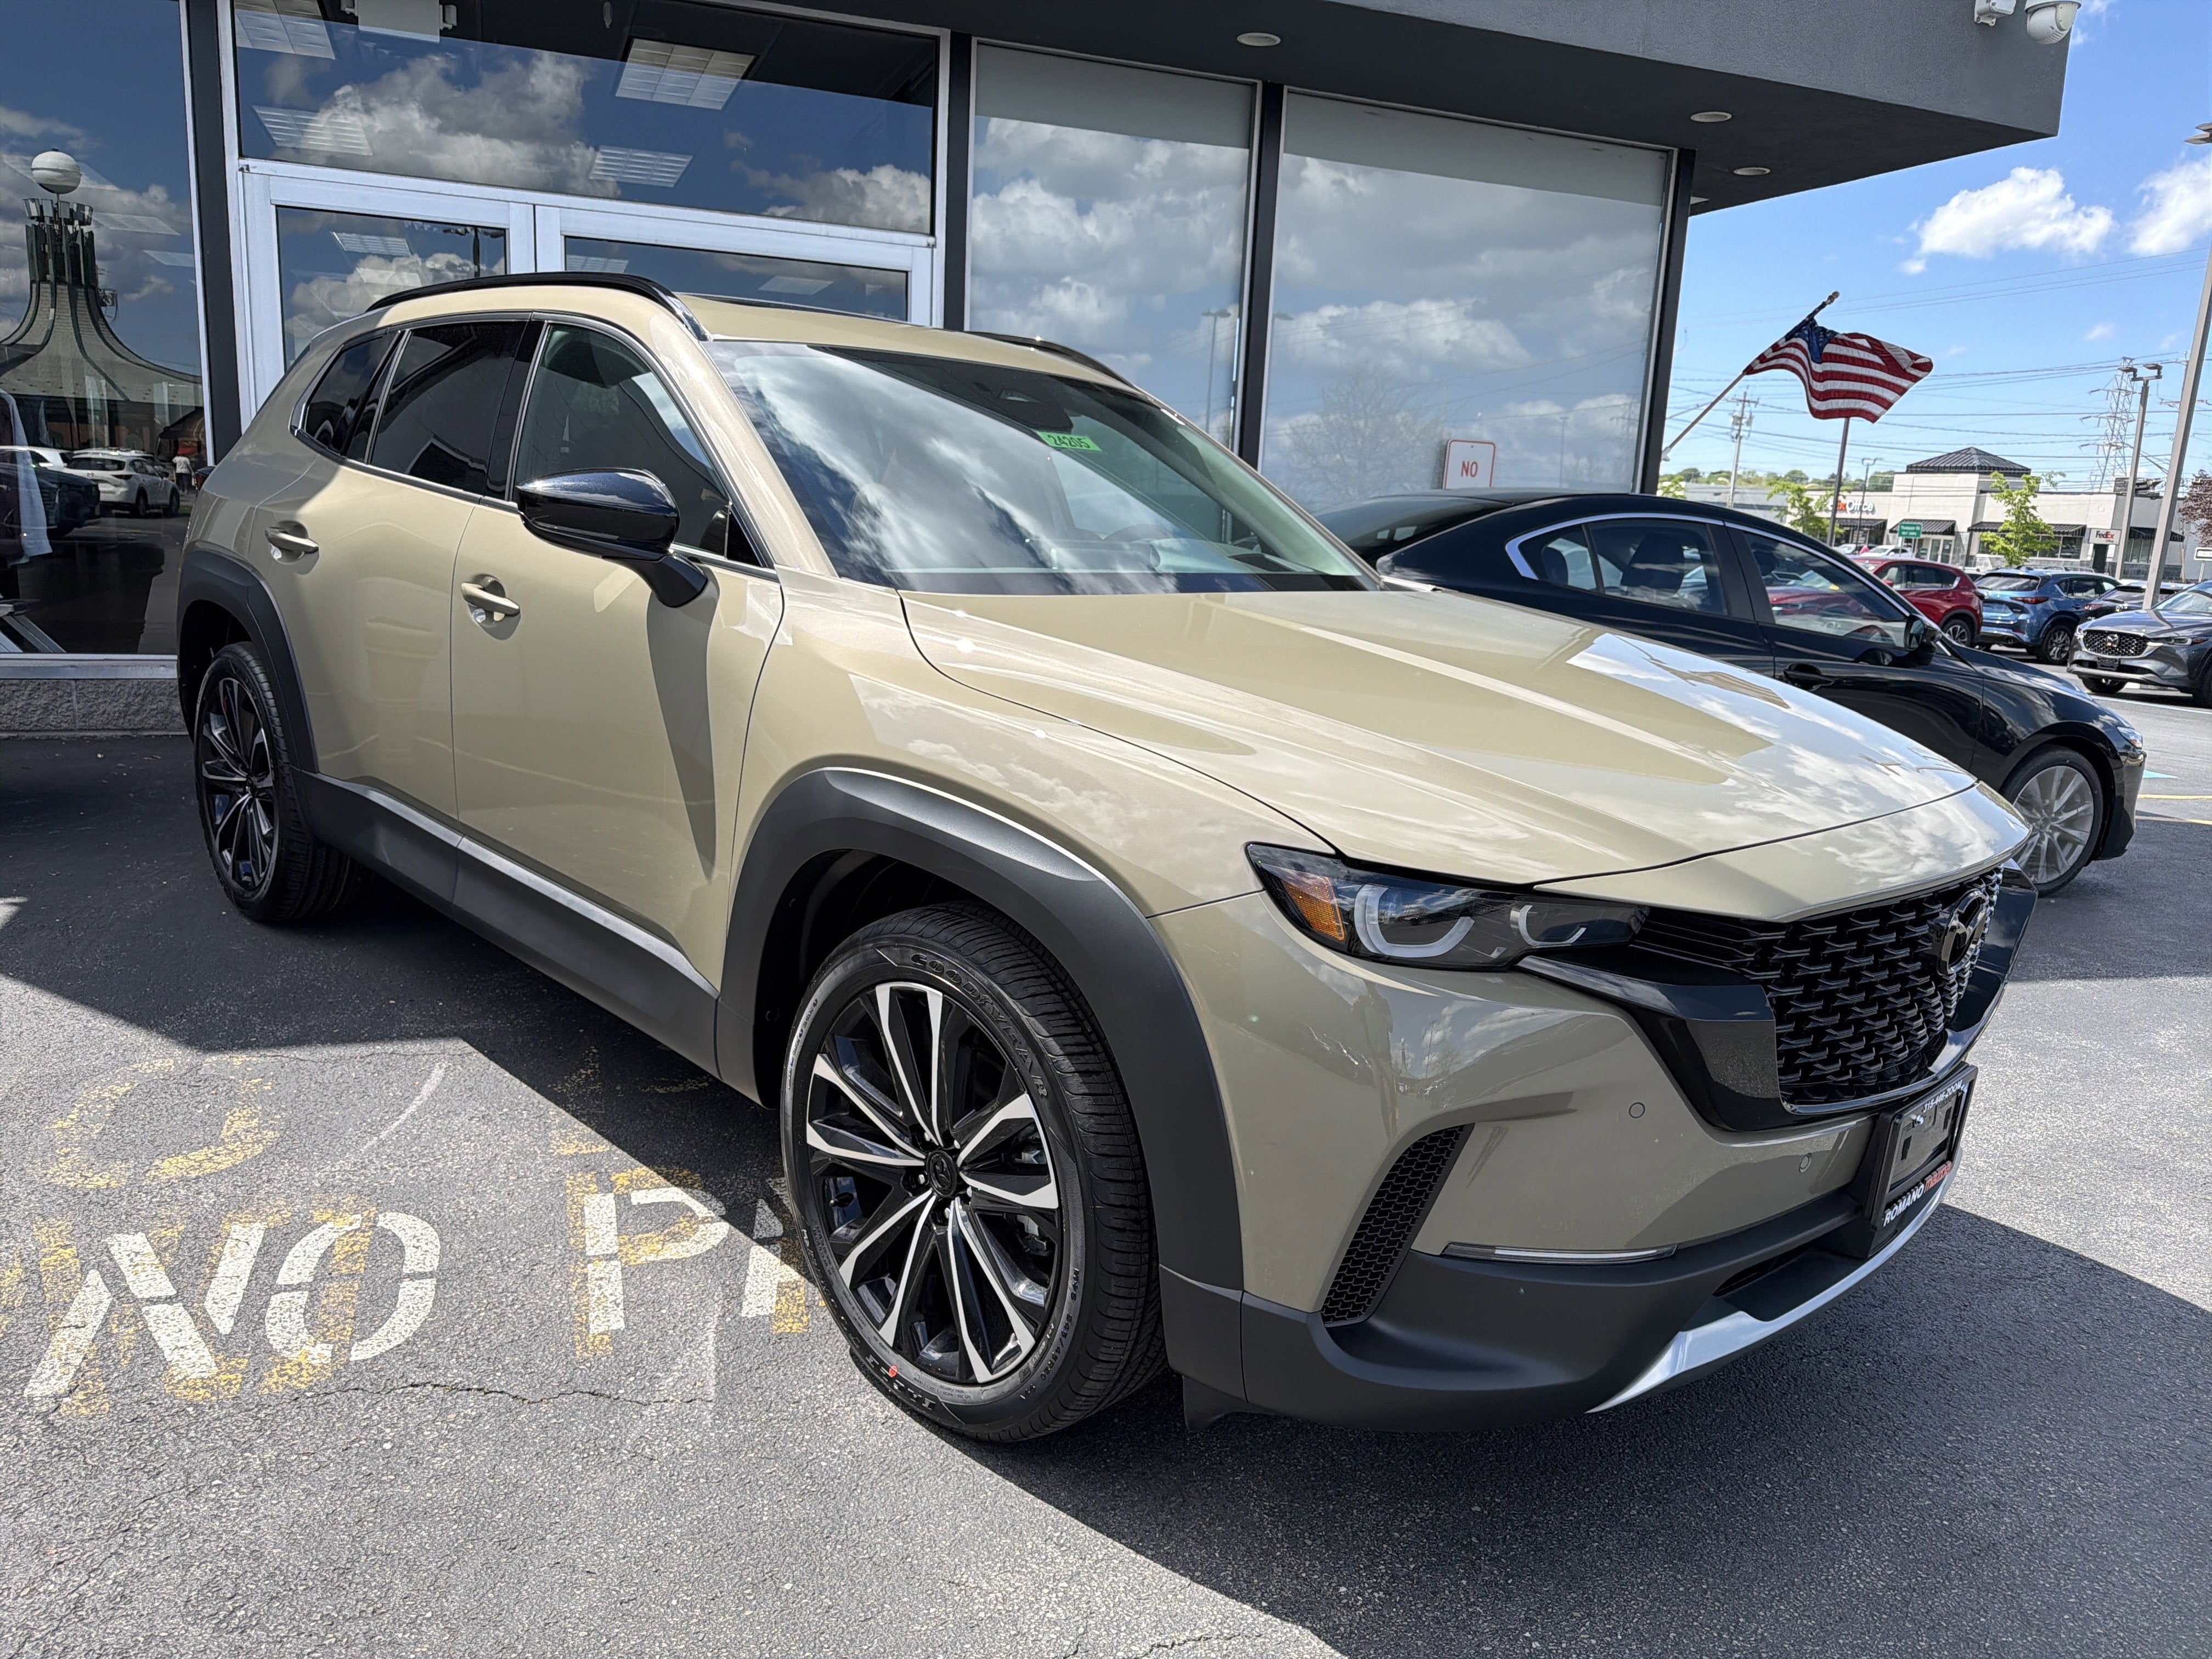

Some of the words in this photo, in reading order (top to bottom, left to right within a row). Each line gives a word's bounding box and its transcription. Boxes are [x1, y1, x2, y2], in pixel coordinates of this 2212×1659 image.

[1047, 435, 1091, 449] 24205
[1460, 461, 1478, 477] NO
[1847, 500, 1874, 511] Offce
[2096, 531, 2115, 539] FedEx
[911, 953, 1048, 1096] GOODYEAR
[1883, 1183, 1925, 1227] ROMANO
[24, 1211, 441, 1398] NO
